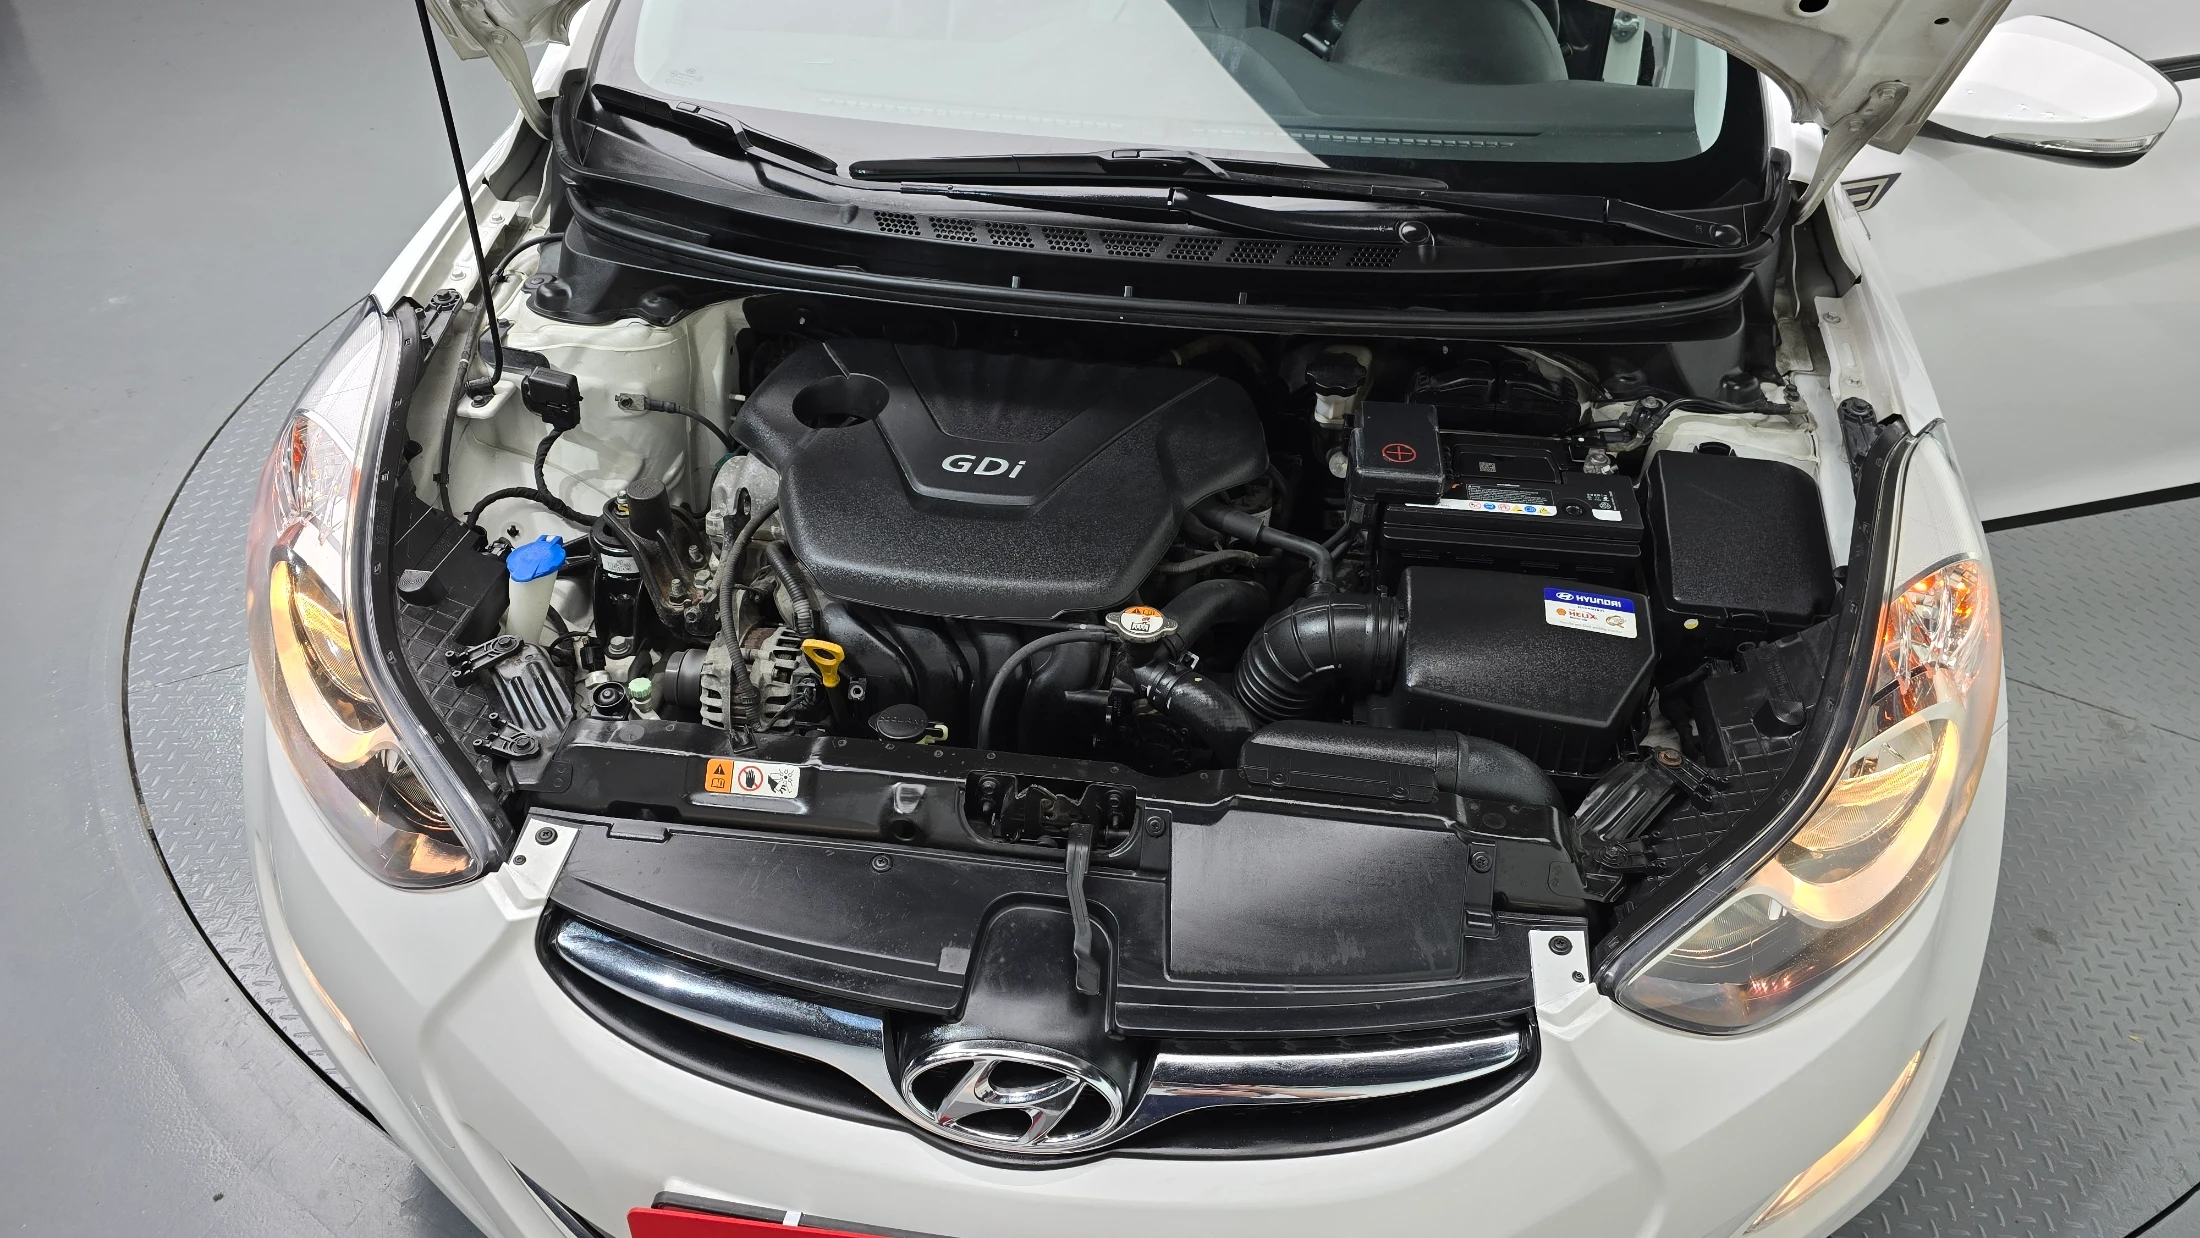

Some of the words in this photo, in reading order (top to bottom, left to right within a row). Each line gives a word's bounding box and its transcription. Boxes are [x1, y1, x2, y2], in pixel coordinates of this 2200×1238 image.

[941, 454, 1027, 479] GDi
[1575, 594, 1622, 608] HYUNDAI
[878, 716, 927, 727] COOLANT
